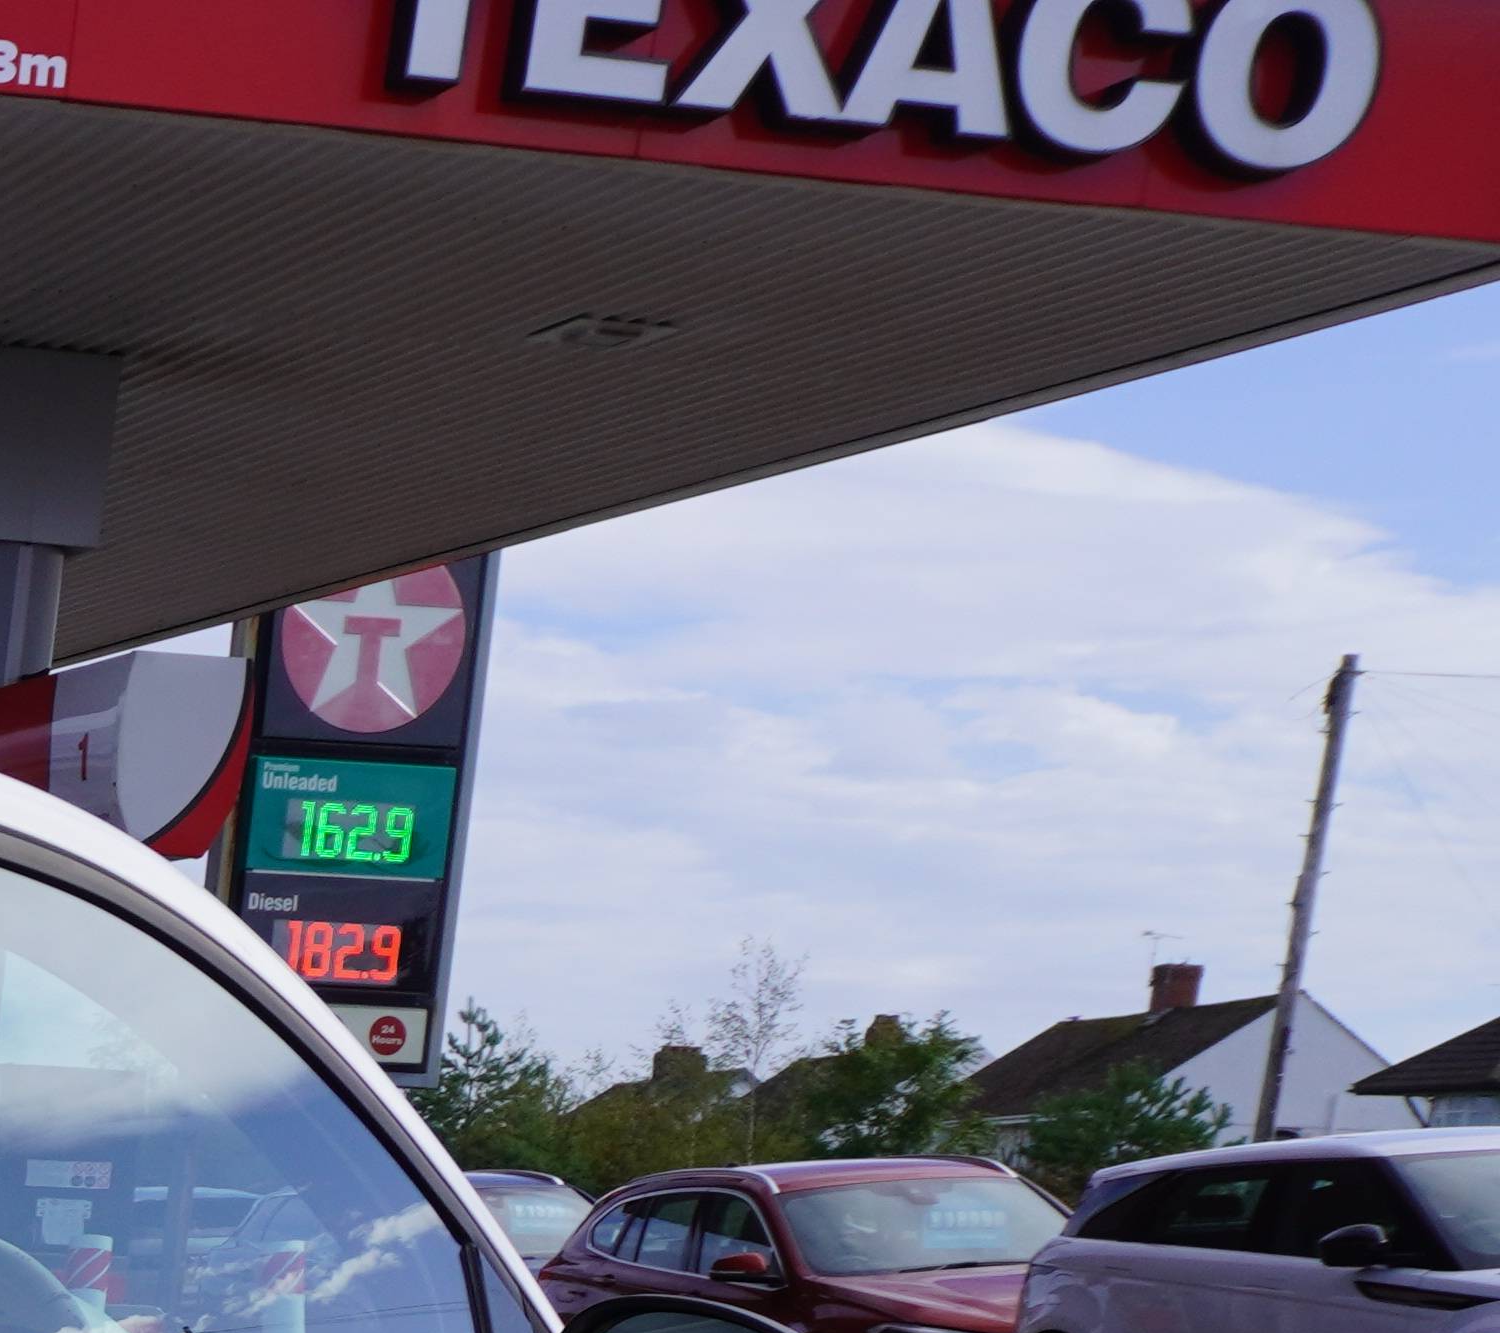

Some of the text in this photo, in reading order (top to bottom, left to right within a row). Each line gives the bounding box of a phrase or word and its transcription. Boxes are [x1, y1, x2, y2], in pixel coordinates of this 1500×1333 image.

[262, 771, 338, 792] Unleaded
[300, 800, 414, 864] 162.9
[248, 892, 299, 913] Diesel
[286, 919, 403, 981] 182.9
[380, 1025, 396, 1034] 24
